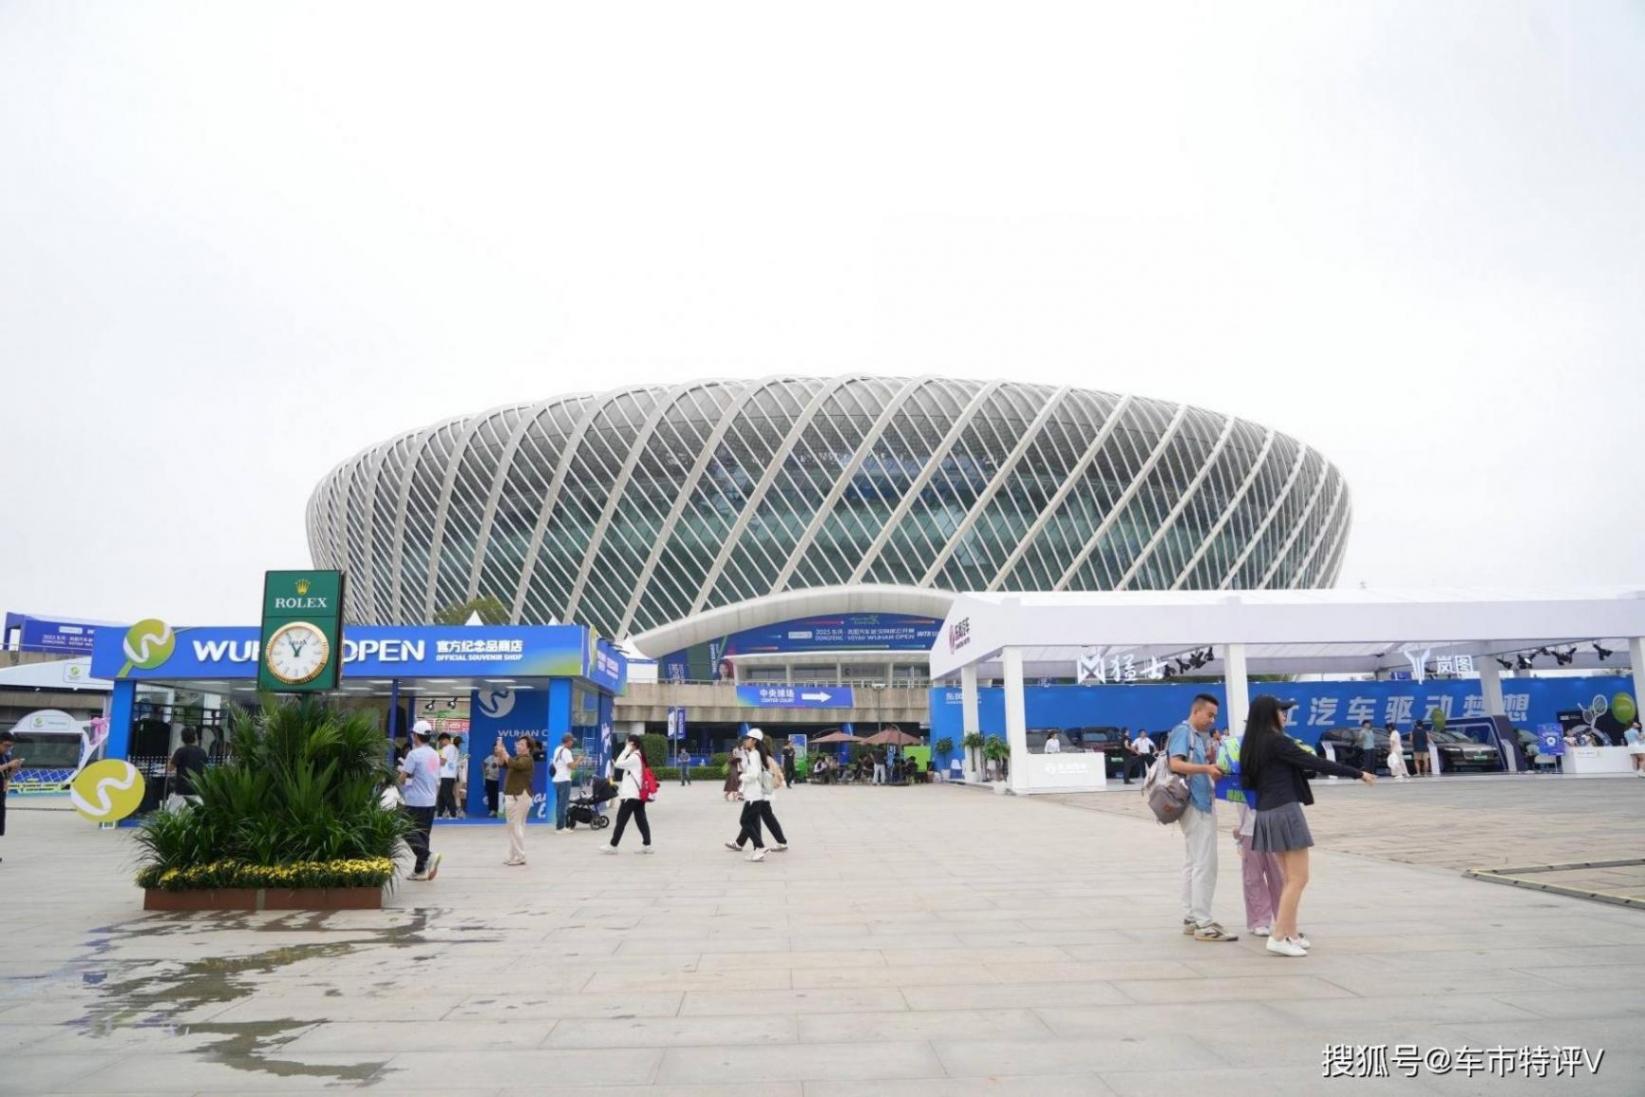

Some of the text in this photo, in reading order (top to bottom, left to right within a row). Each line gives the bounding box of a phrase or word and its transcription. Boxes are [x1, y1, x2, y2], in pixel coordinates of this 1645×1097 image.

[275, 597, 327, 608] ROLEX
[343, 639, 426, 662] OPEN
[436, 640, 523, 653] 官方纪念品商店
[1436, 654, 1473, 676] 岚图
